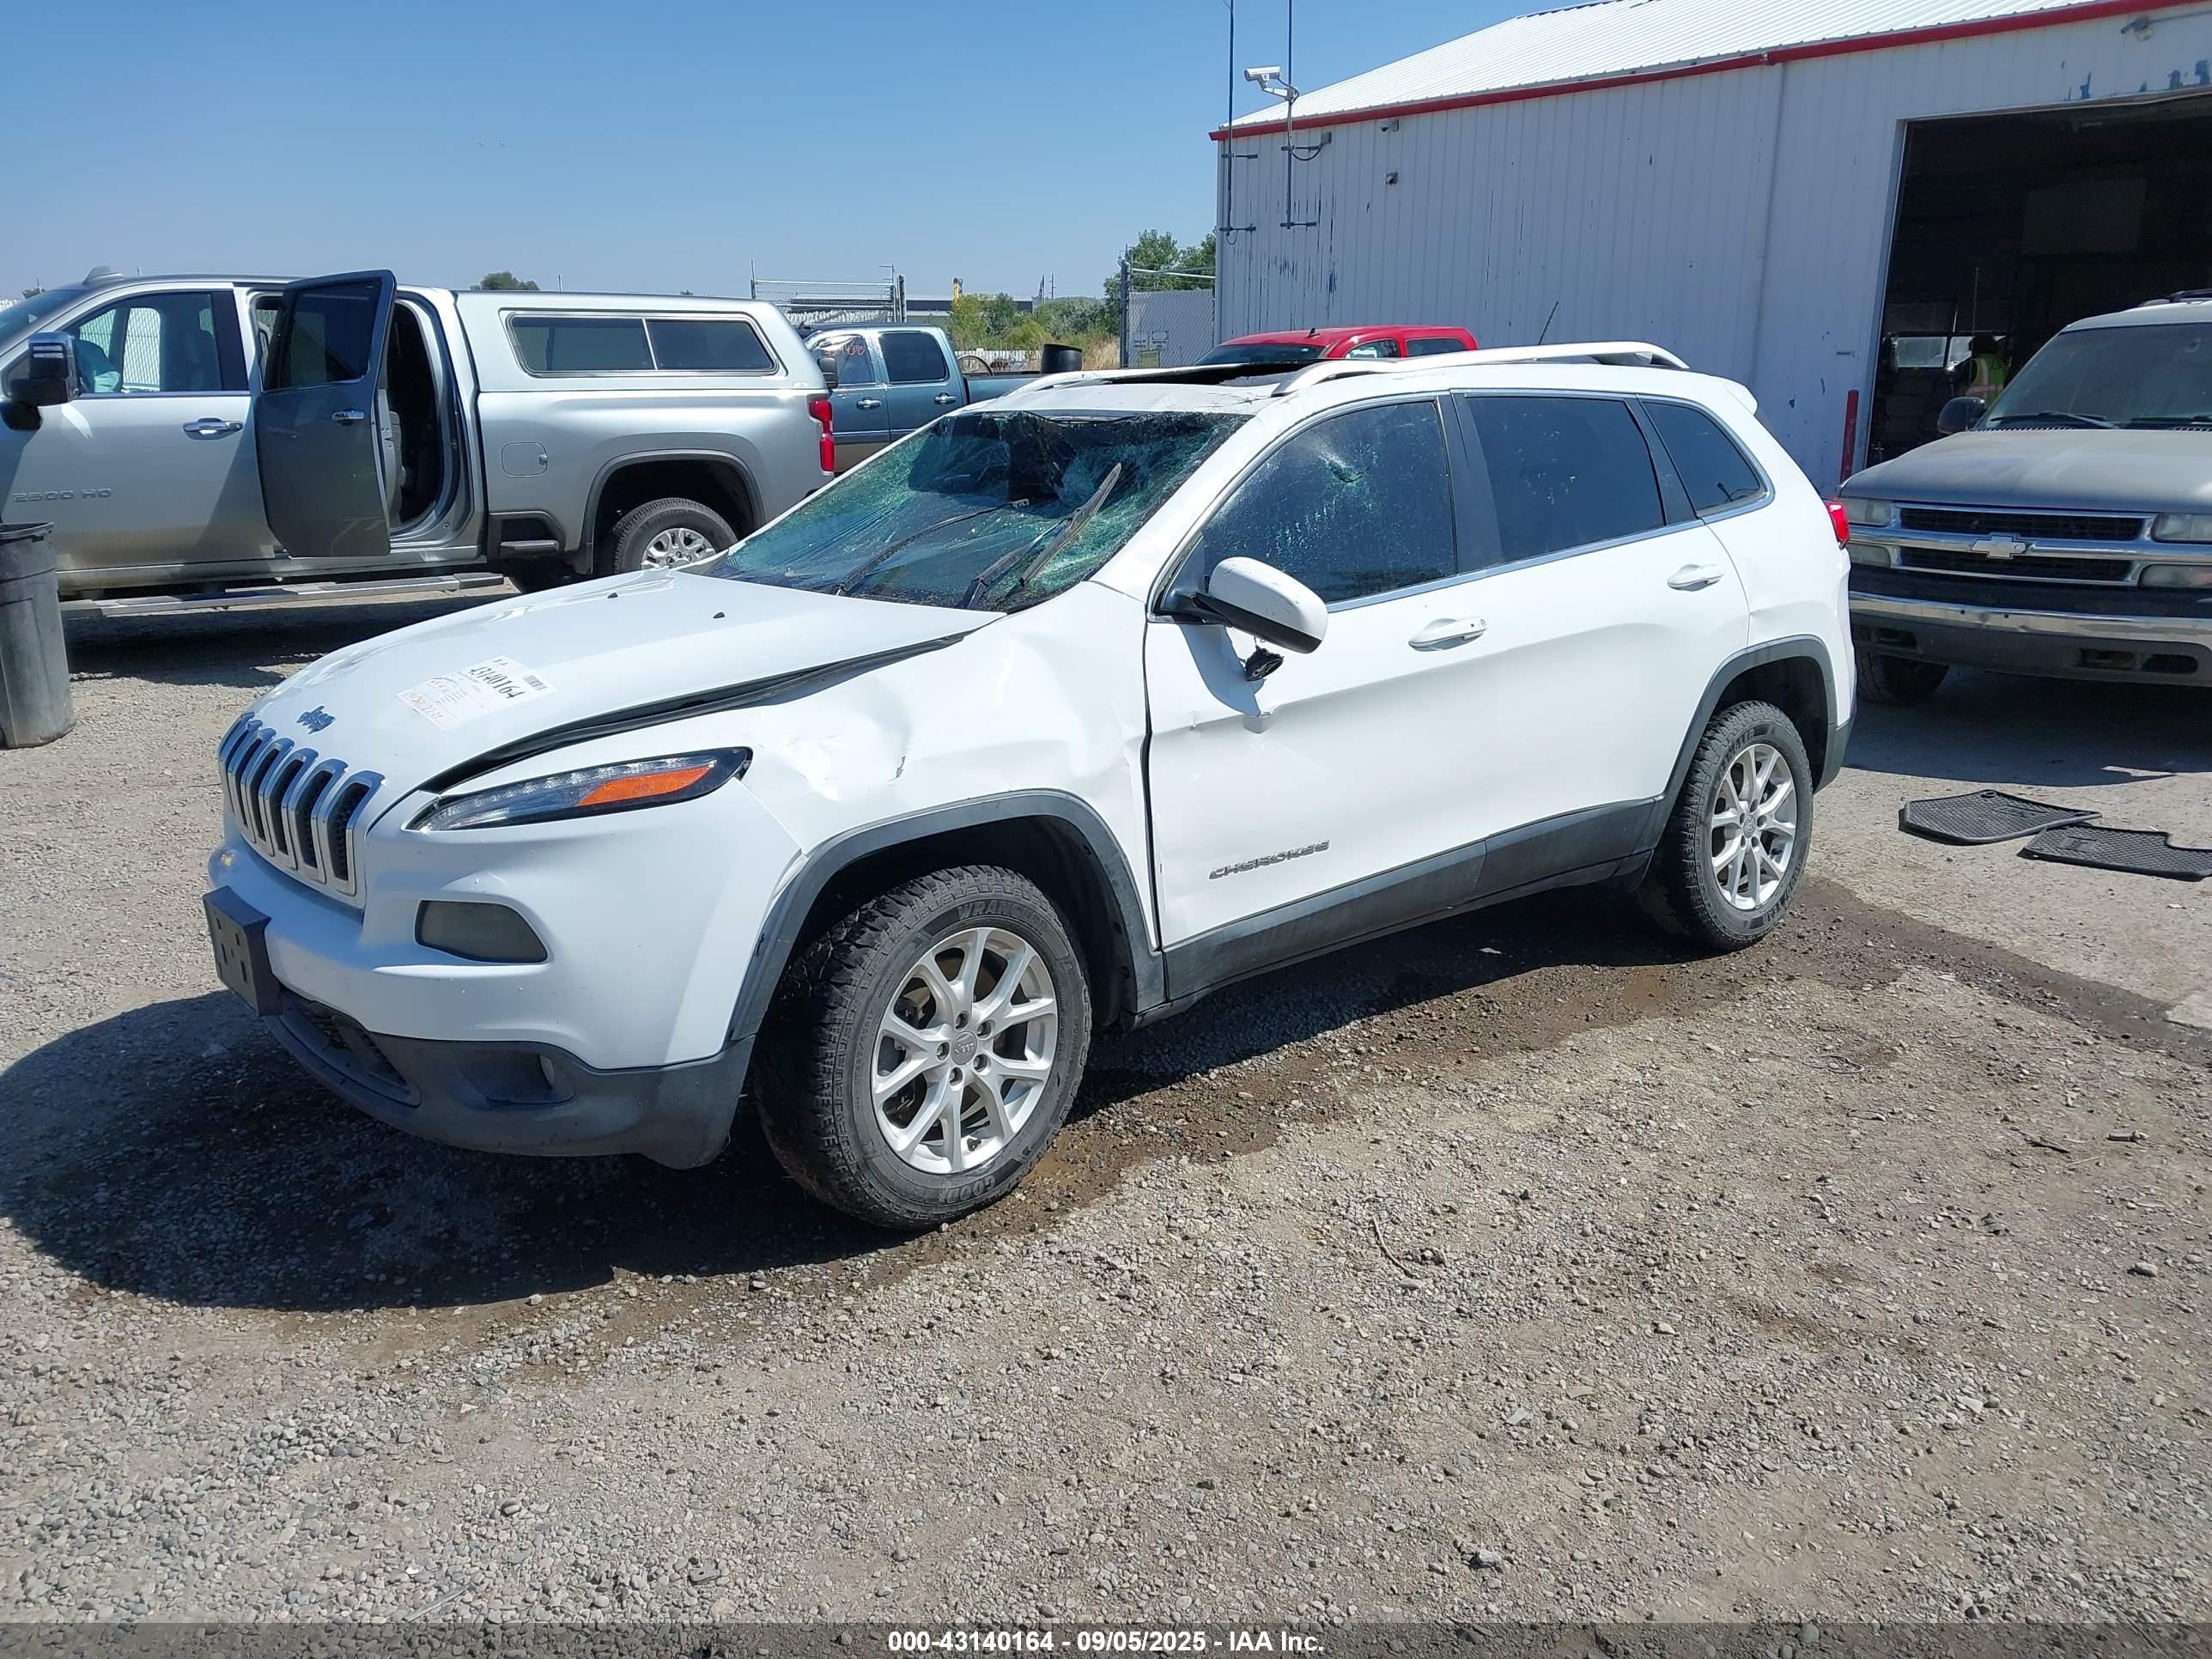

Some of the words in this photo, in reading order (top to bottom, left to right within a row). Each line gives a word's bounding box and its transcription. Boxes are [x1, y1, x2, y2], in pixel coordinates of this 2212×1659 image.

[13, 489, 75, 503] 2500
[82, 487, 112, 499] HD
[468, 665, 526, 700] 43140164
[1208, 840, 1331, 880] CHEROKEE
